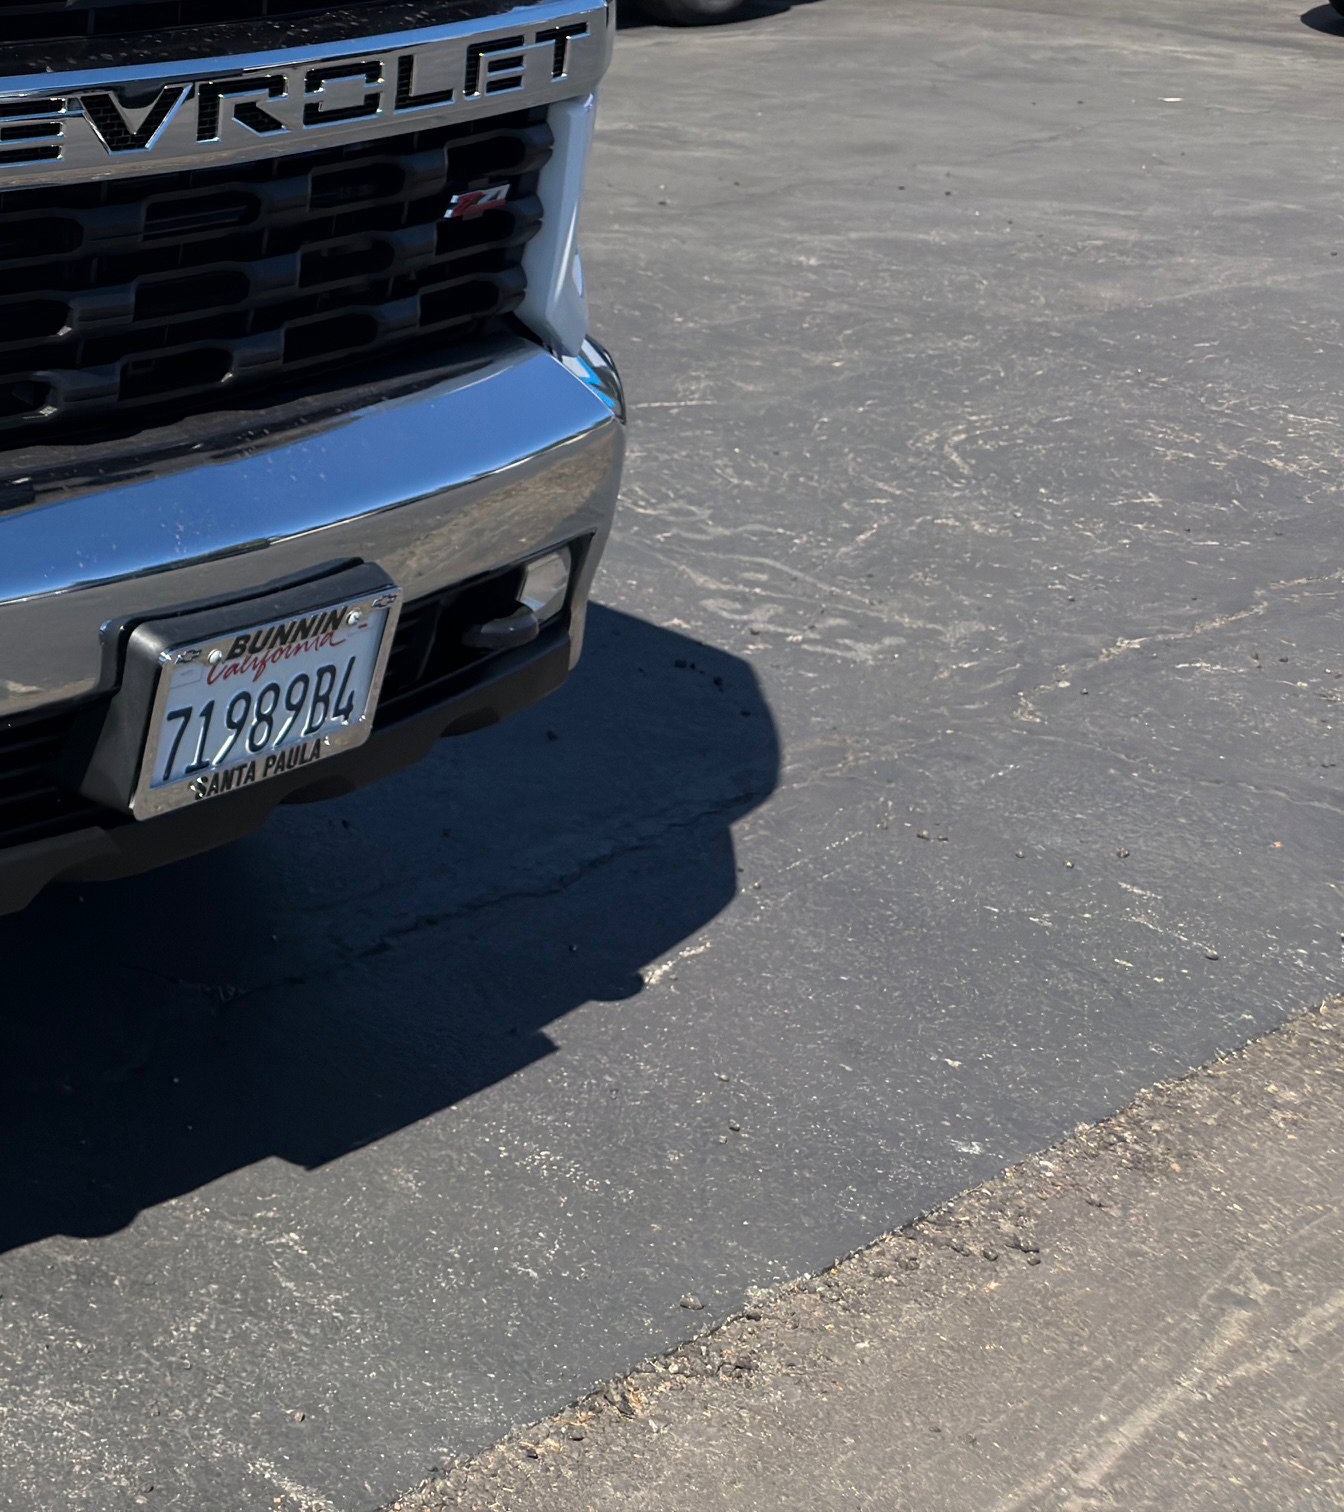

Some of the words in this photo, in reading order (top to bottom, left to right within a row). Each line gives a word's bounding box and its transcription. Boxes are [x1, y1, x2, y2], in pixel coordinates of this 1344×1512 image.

[205, 631, 346, 685] California
[226, 606, 348, 662] BUNNIN
[163, 655, 357, 781] 71989B4
[189, 762, 257, 800] SANTA
[261, 738, 323, 780] PAULA
